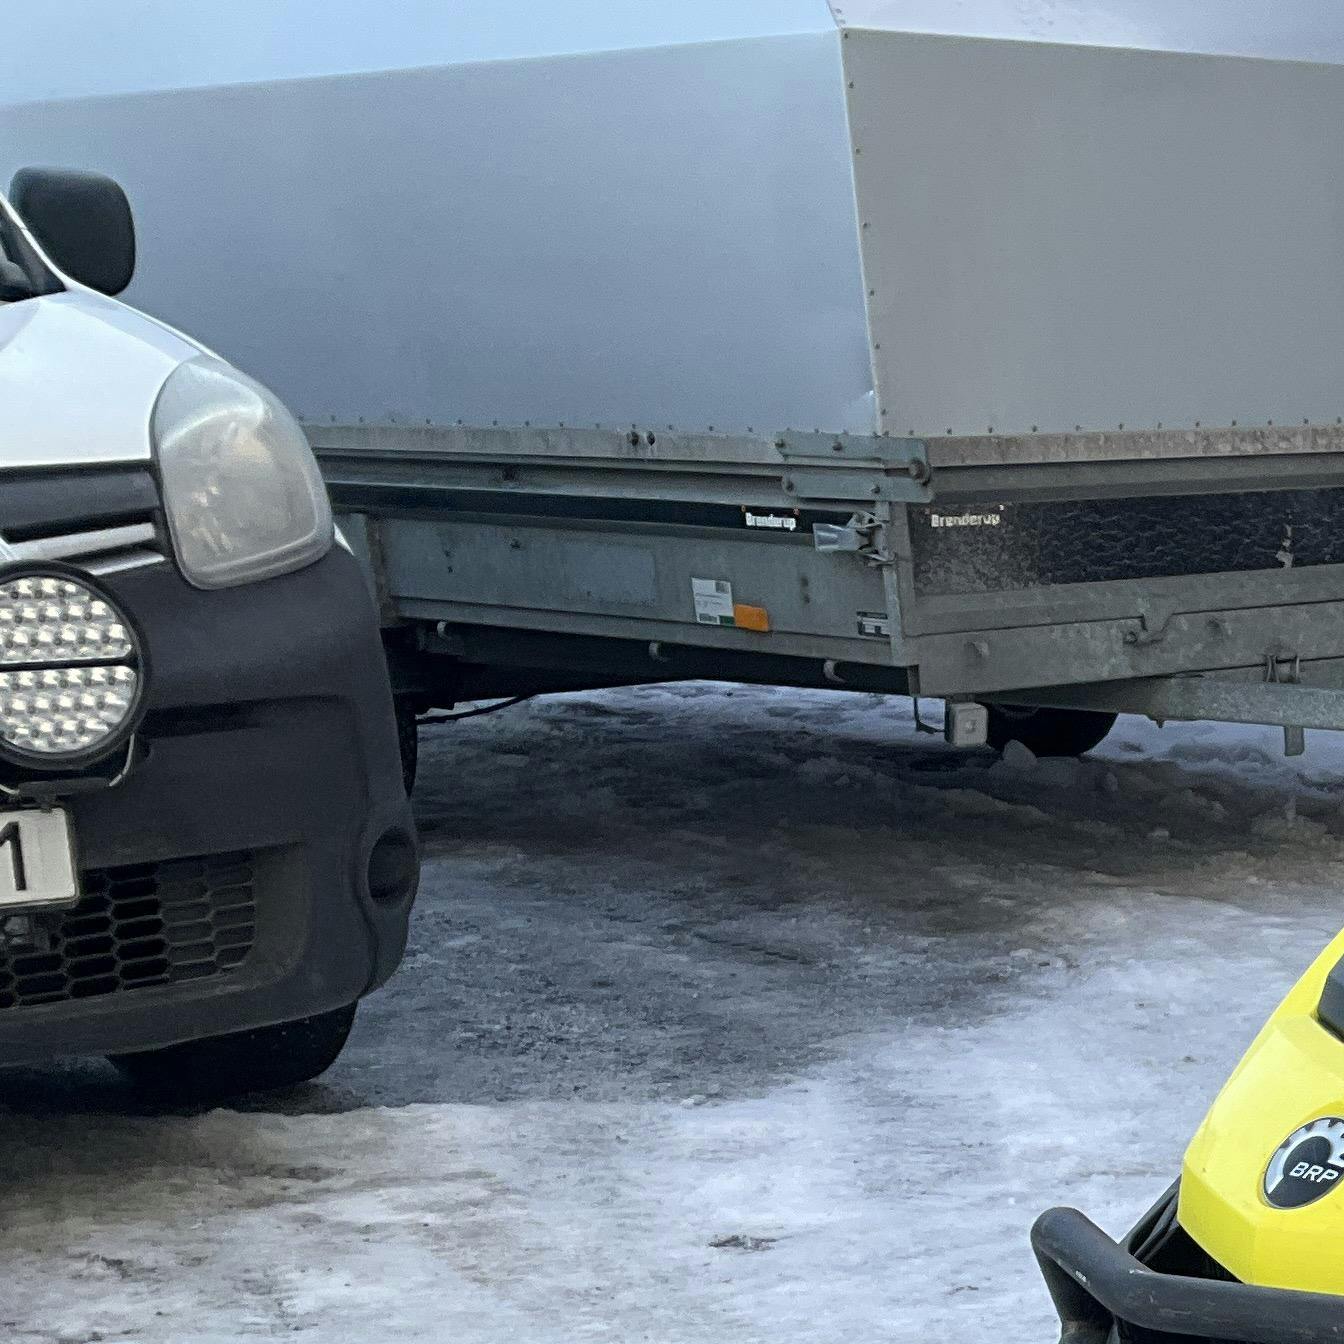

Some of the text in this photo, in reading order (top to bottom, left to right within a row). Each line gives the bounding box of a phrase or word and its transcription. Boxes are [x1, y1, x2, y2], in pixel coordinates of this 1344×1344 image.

[931, 513, 1001, 528] Brenderup
[0, 821, 26, 891] 1
[1289, 1161, 1339, 1183] BRP
